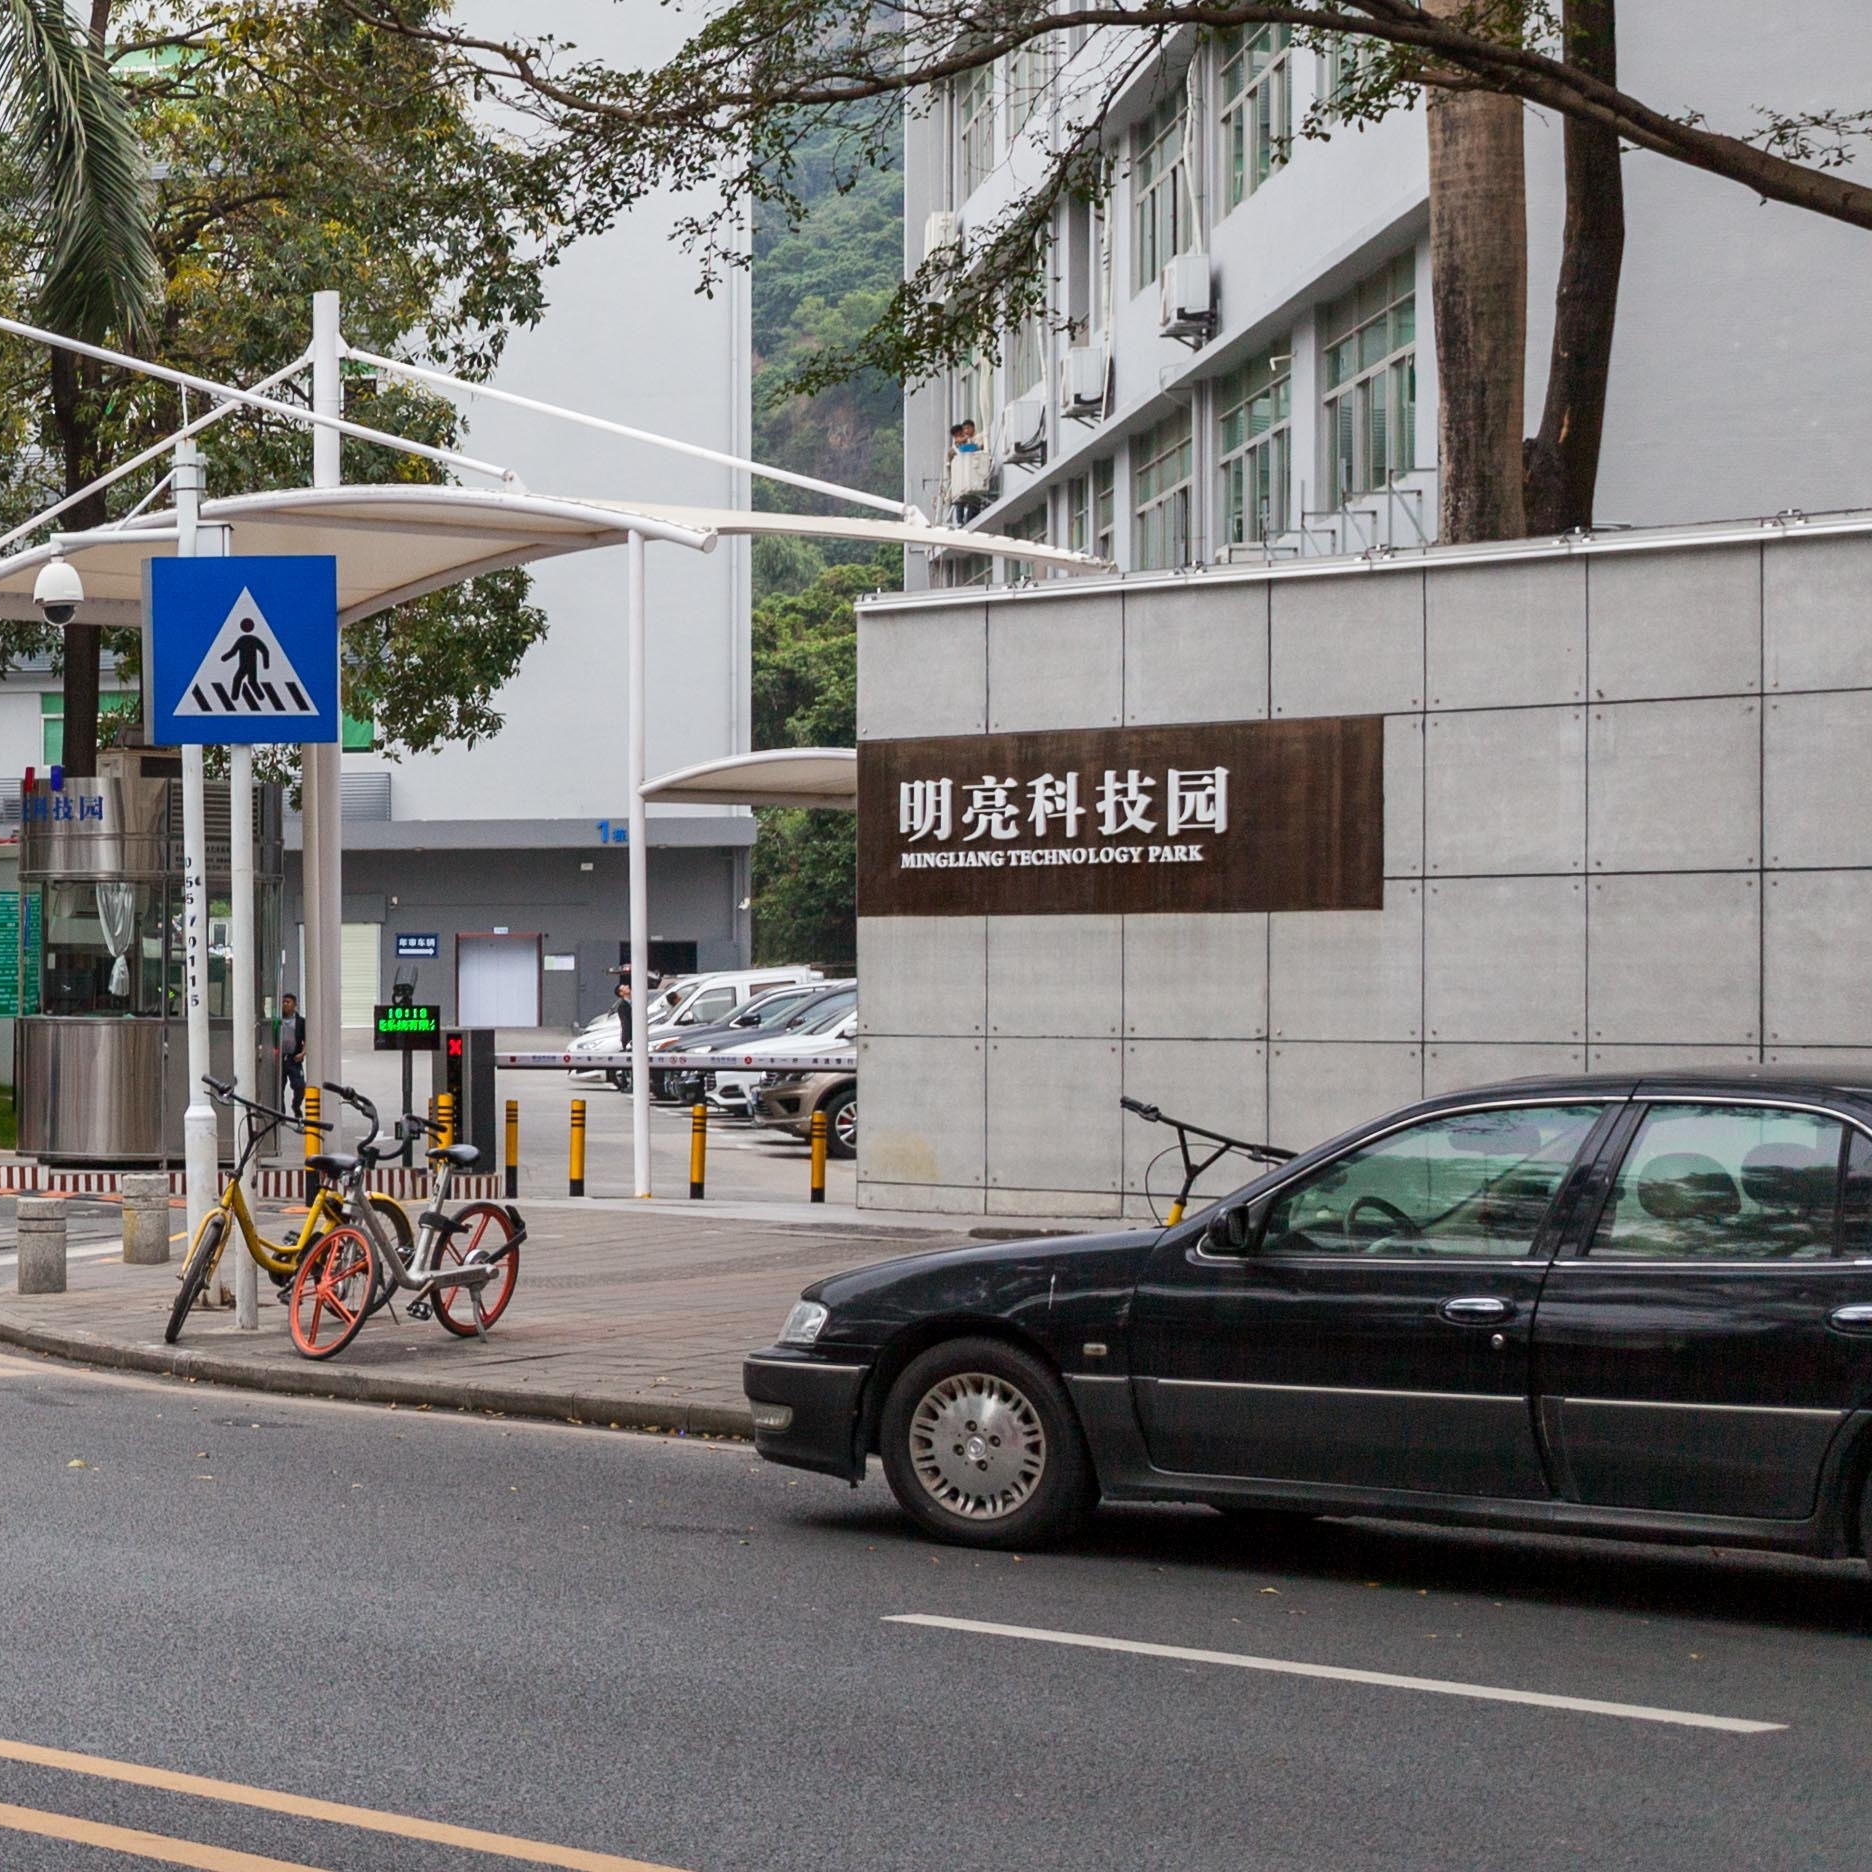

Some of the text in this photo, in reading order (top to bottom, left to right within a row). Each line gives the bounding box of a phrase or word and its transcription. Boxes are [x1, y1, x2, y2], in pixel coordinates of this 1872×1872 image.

[899, 766, 1230, 842] 明亮科技园
[901, 843, 1204, 869] MINGLIANG TECHNOLOGY PARK
